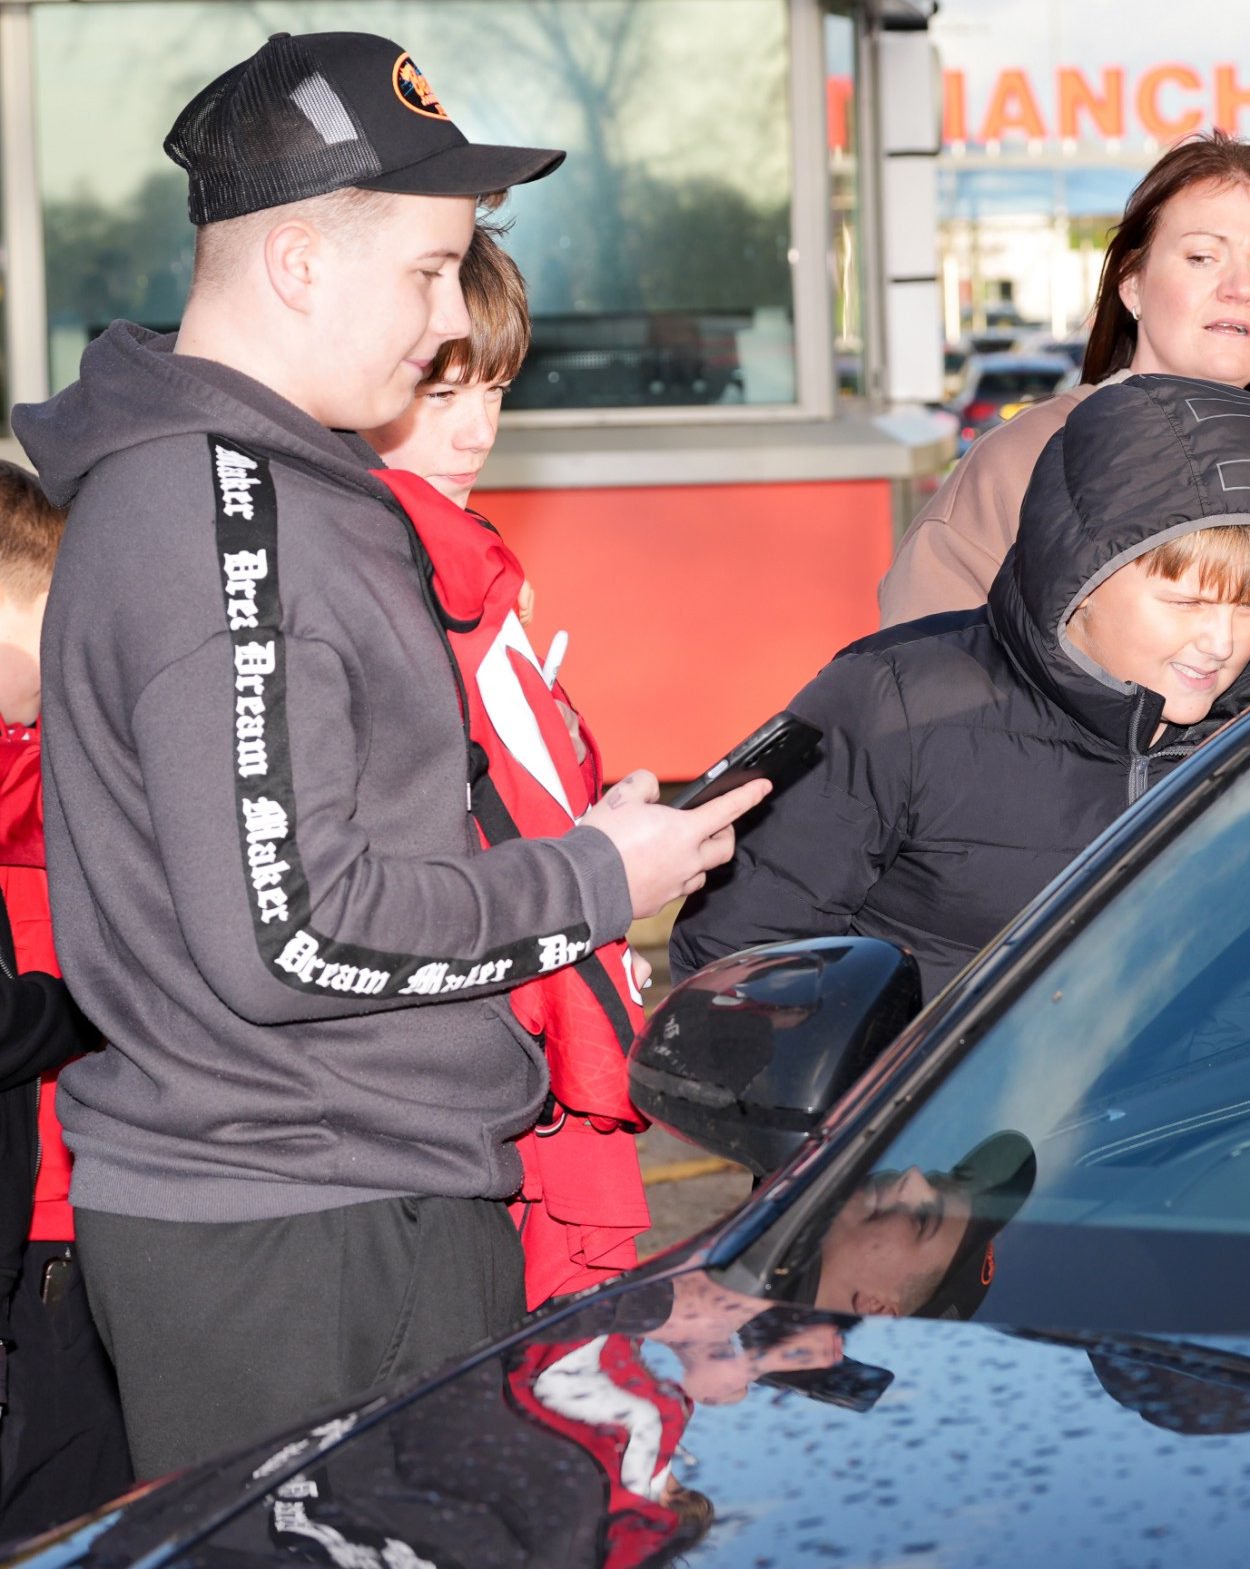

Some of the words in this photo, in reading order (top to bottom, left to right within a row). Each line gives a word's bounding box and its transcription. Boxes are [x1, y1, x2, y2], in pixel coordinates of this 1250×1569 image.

[234, 640, 275, 779] Dream
[241, 796, 291, 924] Maker
[274, 929, 391, 995] Dream
